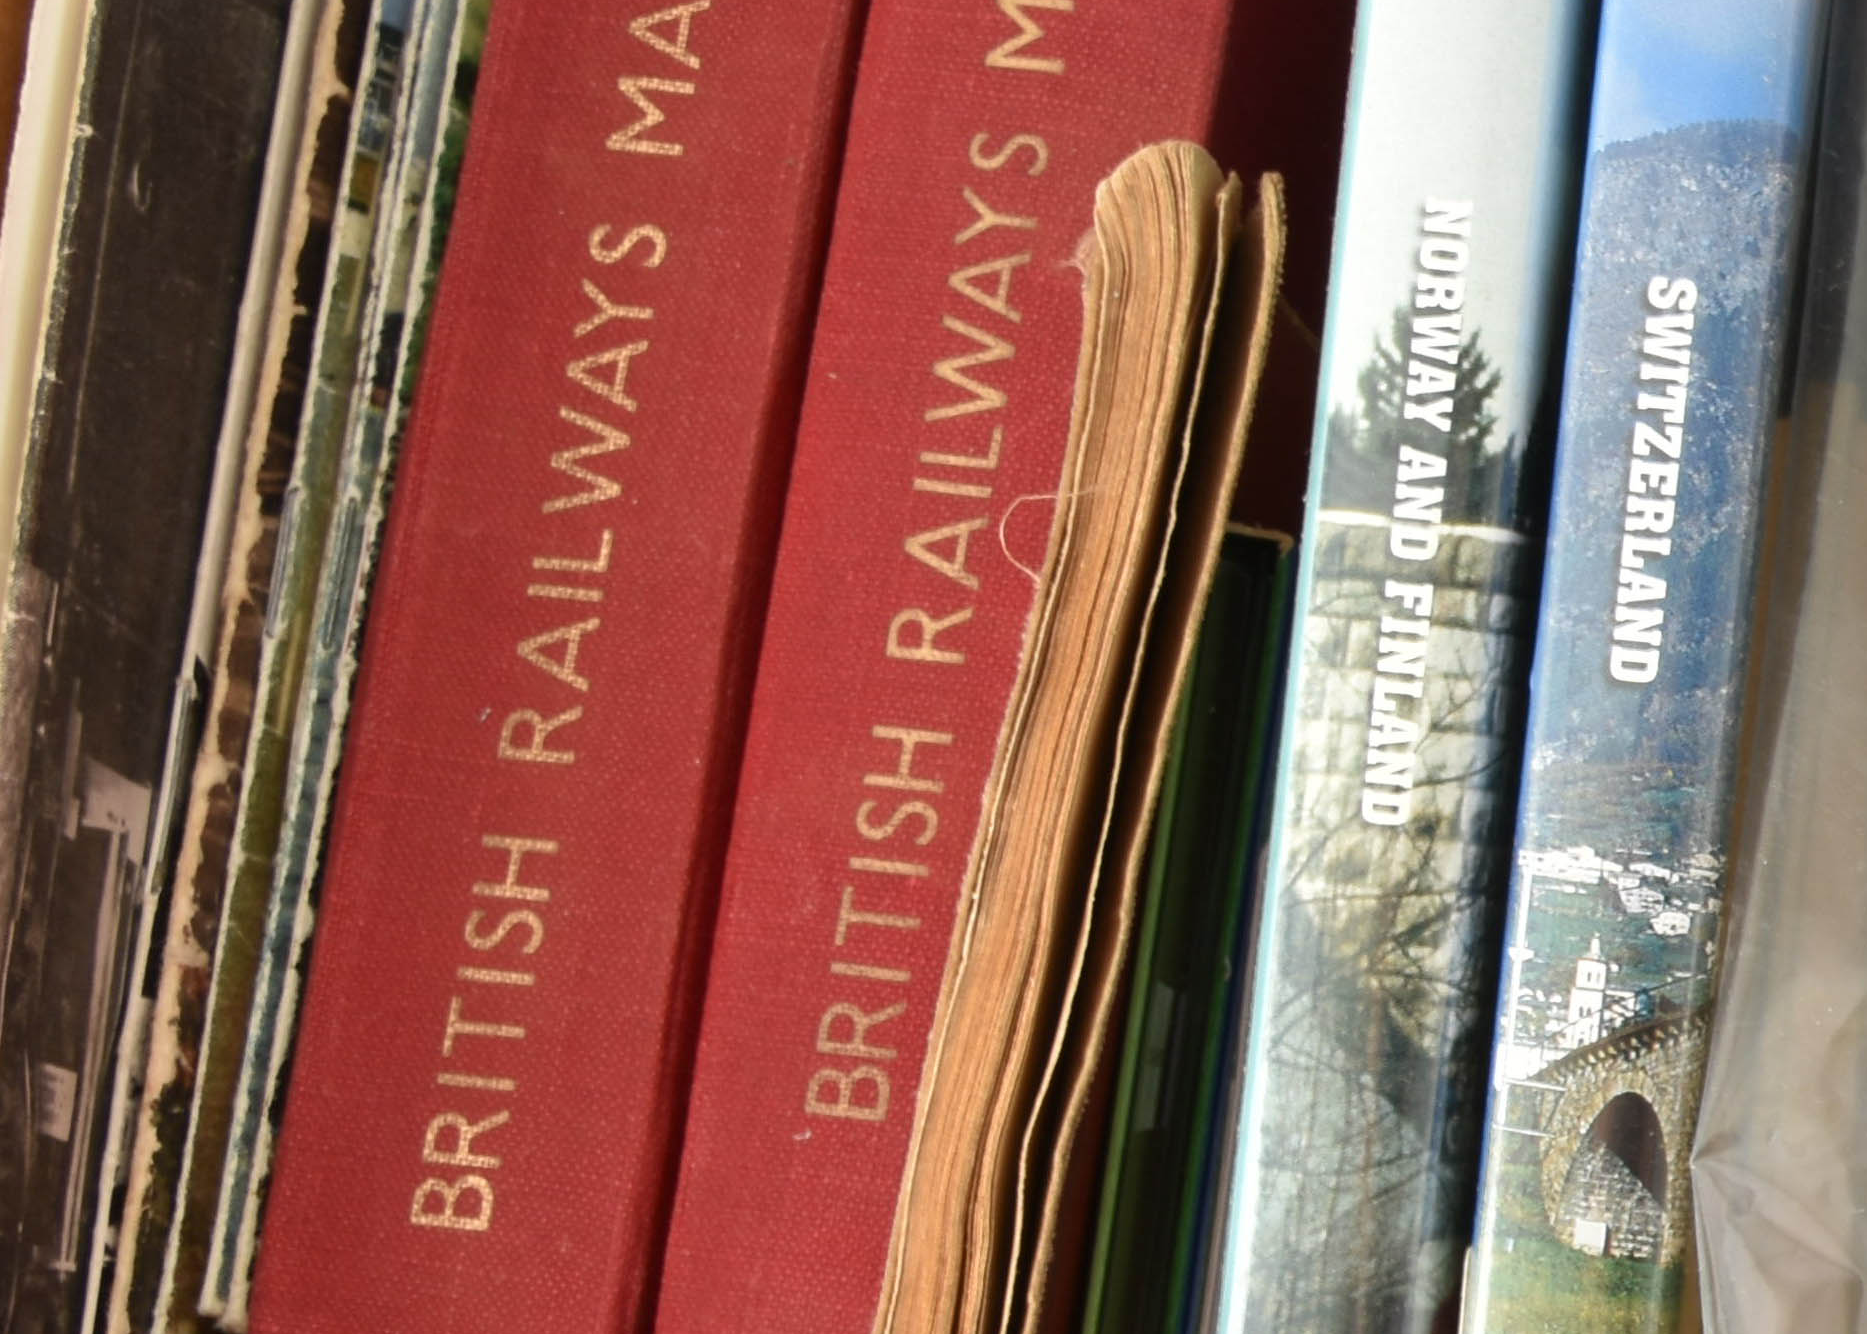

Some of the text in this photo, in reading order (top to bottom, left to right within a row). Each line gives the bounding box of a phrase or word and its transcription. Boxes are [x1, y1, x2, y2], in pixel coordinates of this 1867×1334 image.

[409, 833, 561, 1233] BRITISH
[496, 222, 668, 766] RAILWAYS
[804, 724, 955, 1122] BRITISH
[884, 131, 1049, 666] RAILWAYS
[1361, 195, 1475, 827] NORWAY AND FINLAND
[1609, 274, 1699, 686] SWITZERLAND
